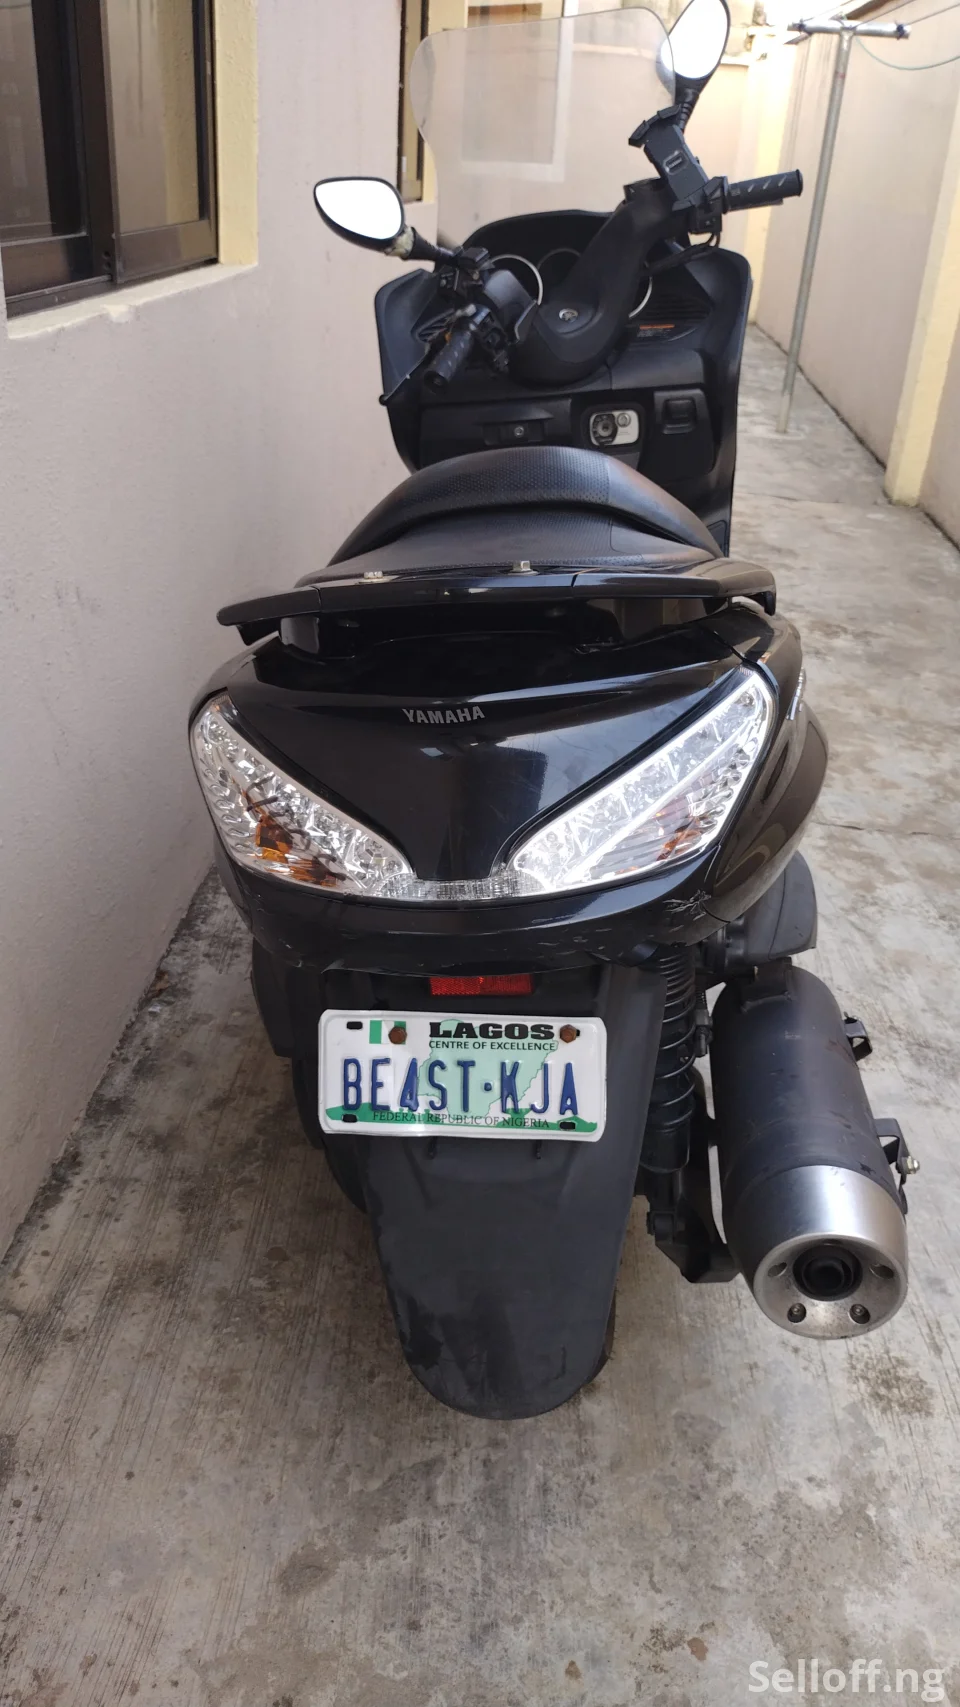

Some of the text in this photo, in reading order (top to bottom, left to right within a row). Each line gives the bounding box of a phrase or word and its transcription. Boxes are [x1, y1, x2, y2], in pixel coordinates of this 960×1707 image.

[402, 706, 485, 723] YAMAHA
[429, 1022, 555, 1040] LAGOS
[429, 1040, 556, 1051] CENTRE OF EXCELLENCE
[372, 1111, 550, 1129] FEDERAL REPUBLIC OF NIGERIA
